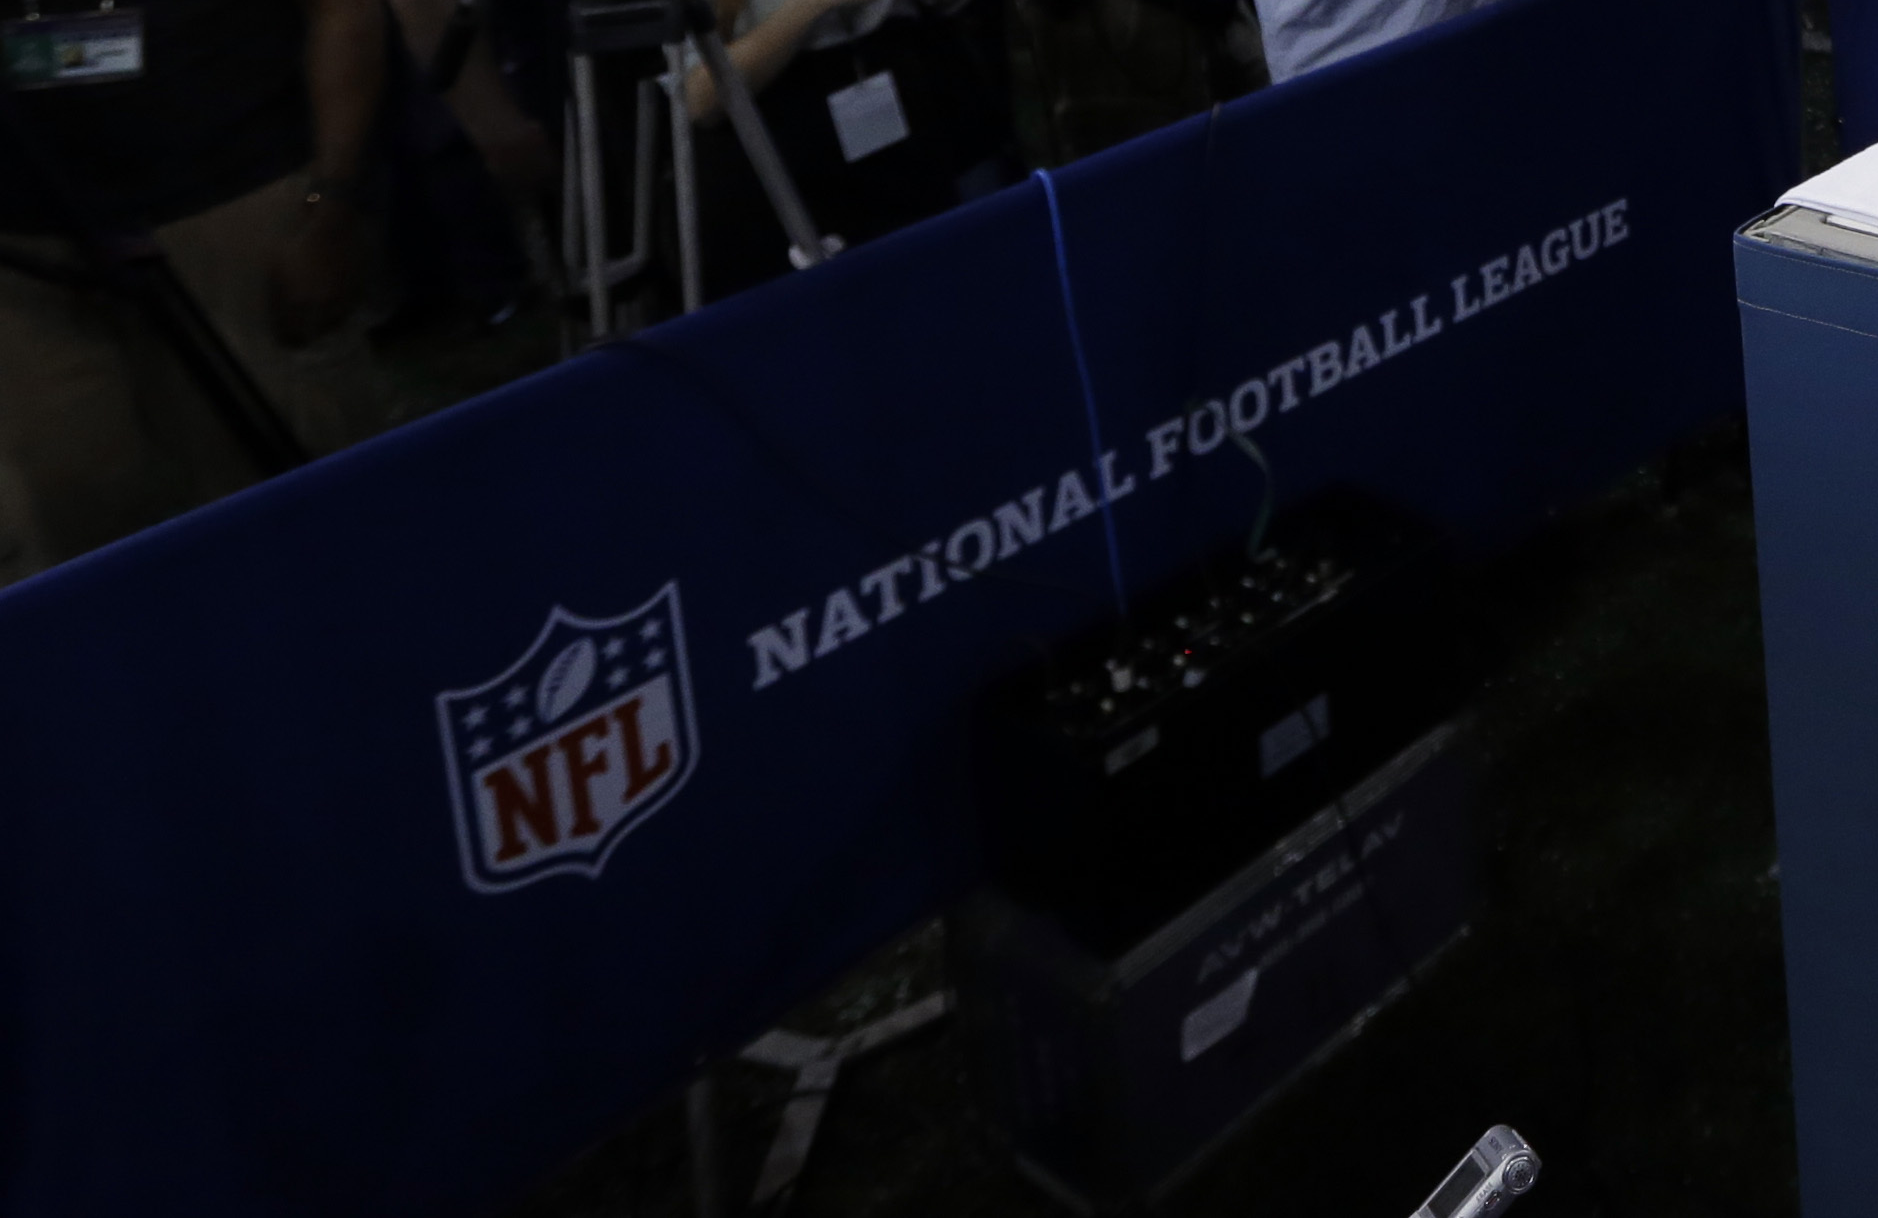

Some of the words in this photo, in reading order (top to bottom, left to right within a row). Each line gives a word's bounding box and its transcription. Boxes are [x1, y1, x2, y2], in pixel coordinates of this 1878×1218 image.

[746, 451, 1136, 689] NATIONAL
[1146, 293, 1443, 480] FOOTBALL
[1450, 197, 1630, 323] LEAGUE
[482, 694, 672, 864] NFL
